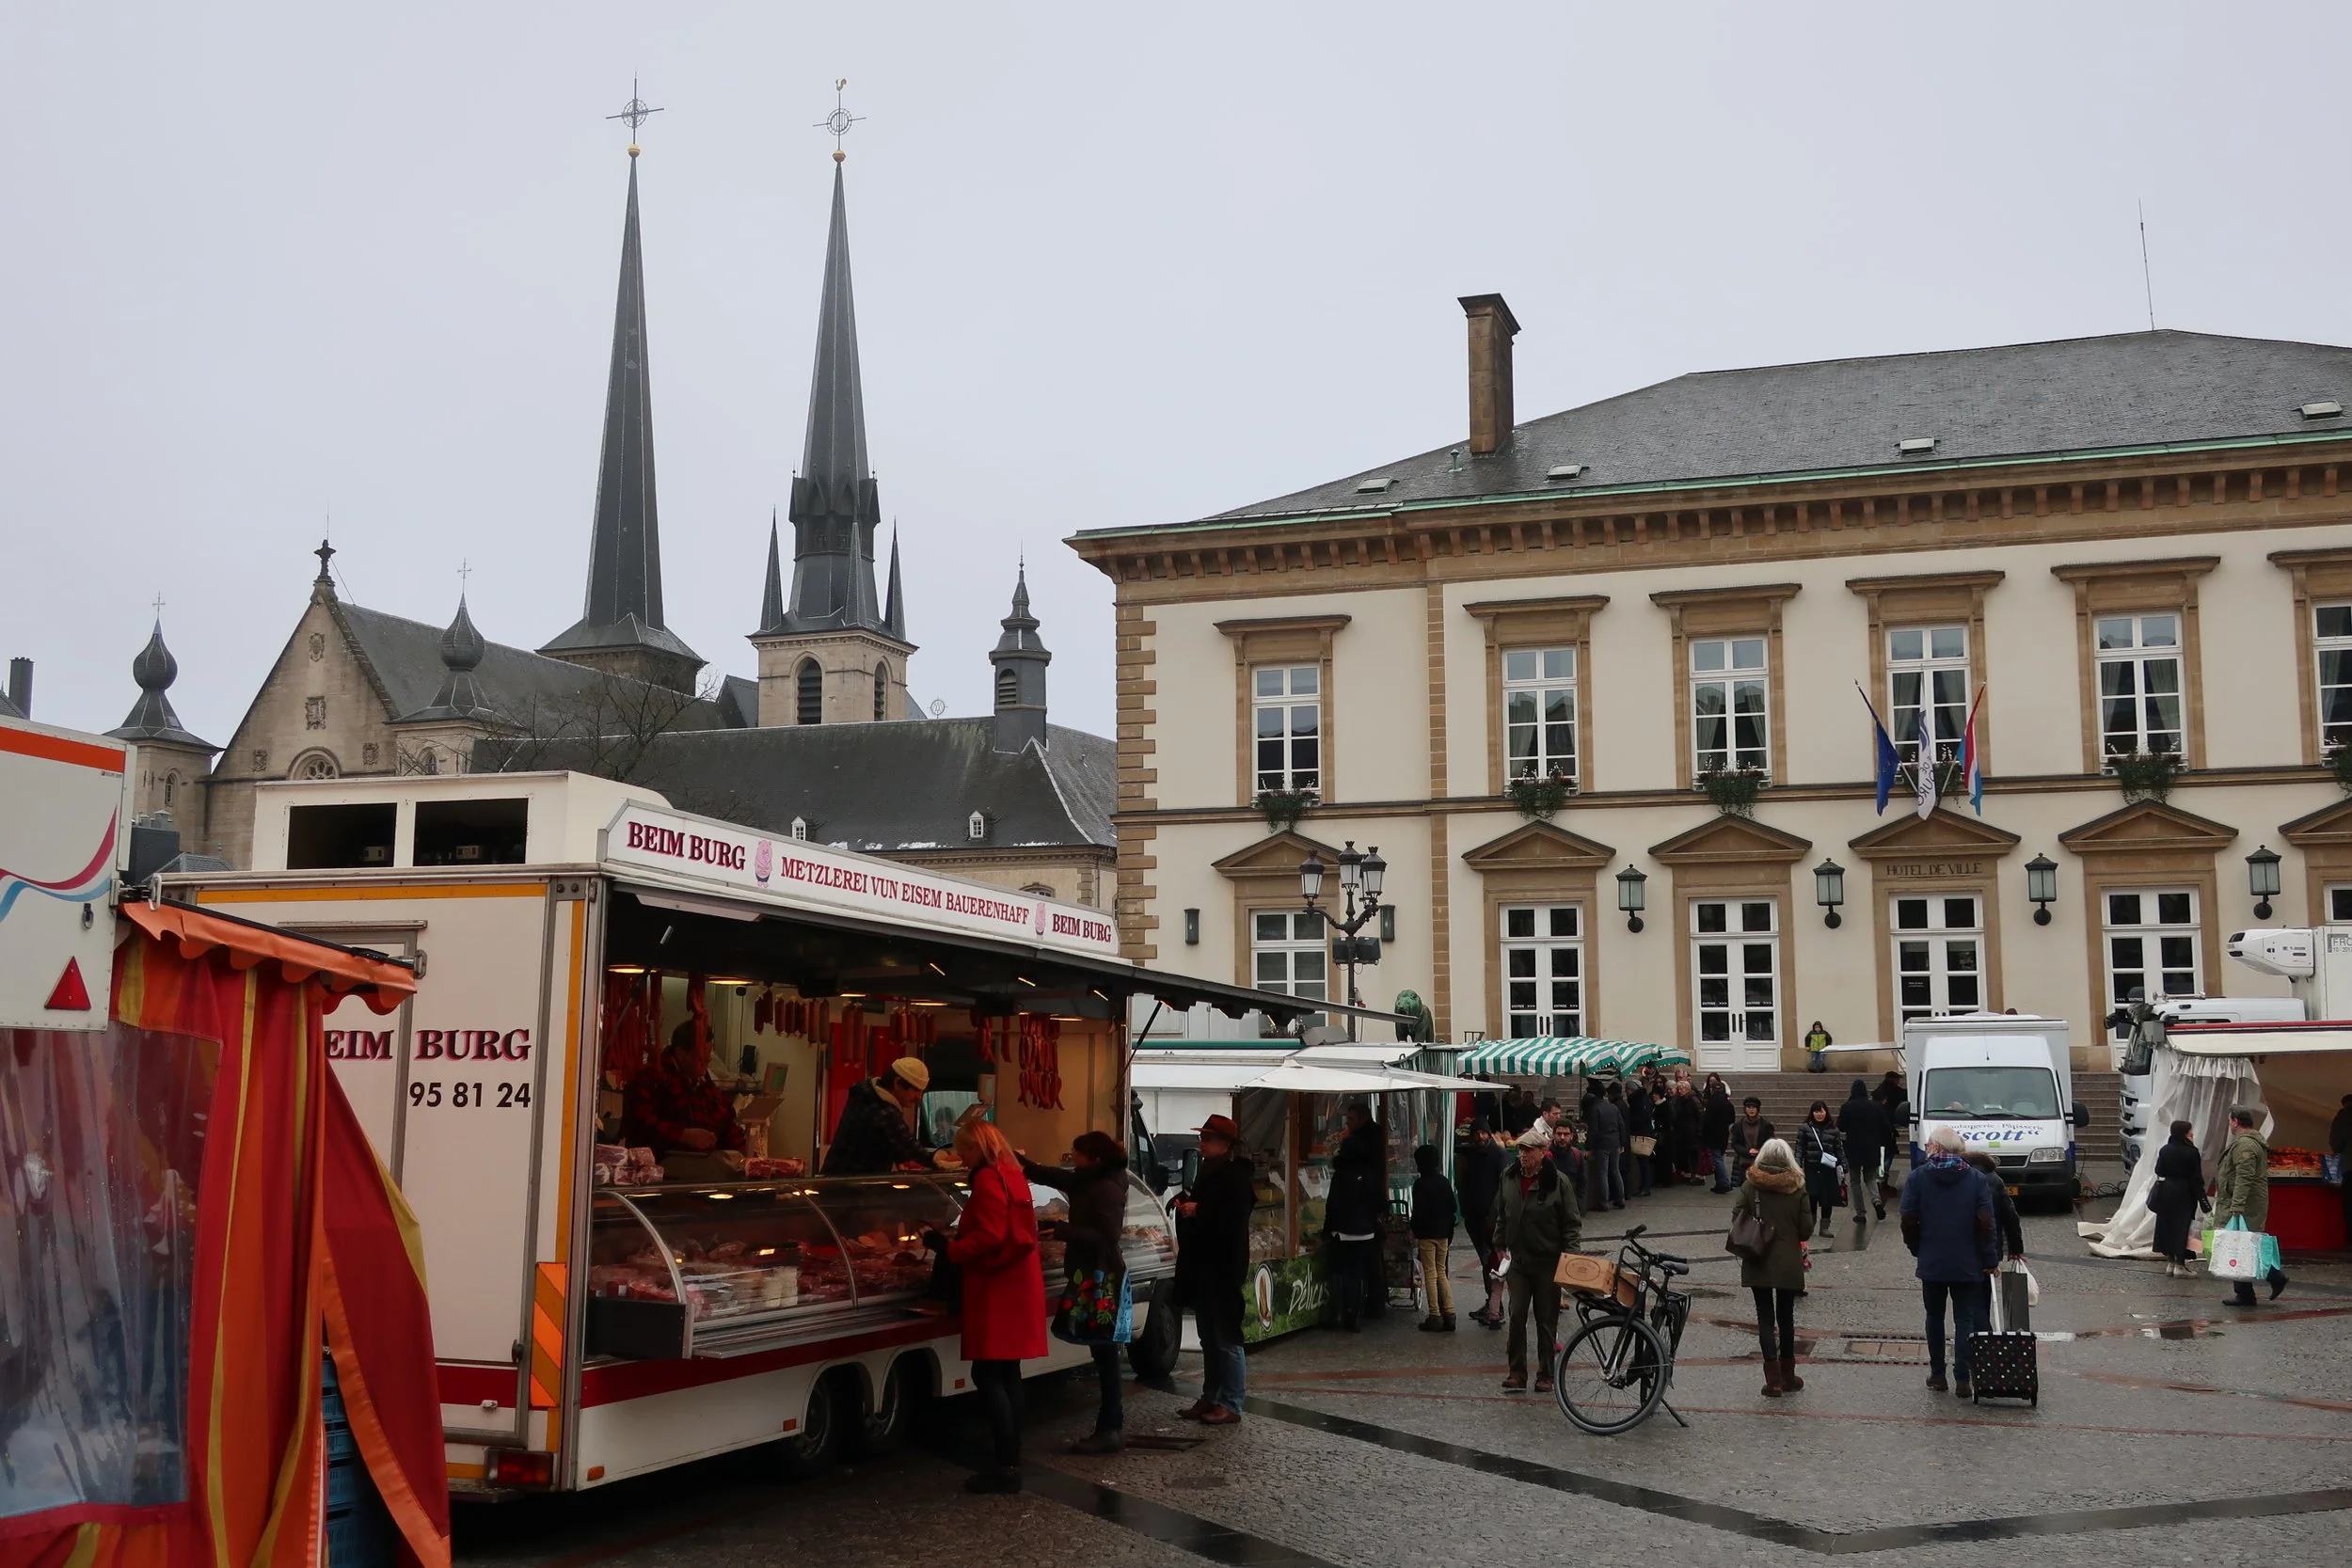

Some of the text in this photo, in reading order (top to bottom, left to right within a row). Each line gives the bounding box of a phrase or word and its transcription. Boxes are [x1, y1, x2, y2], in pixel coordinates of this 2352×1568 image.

[627, 820, 746, 871] BEIM BURG
[1929, 863, 1947, 876] DE
[1949, 863, 1982, 875] VILLE
[780, 856, 1030, 926] METZLEREI VUN EISEM BAUERENHAFF
[1051, 912, 1112, 943] BEIM BURG
[324, 1028, 532, 1062] EIM BURG
[409, 1082, 532, 1108] 95 81 24
